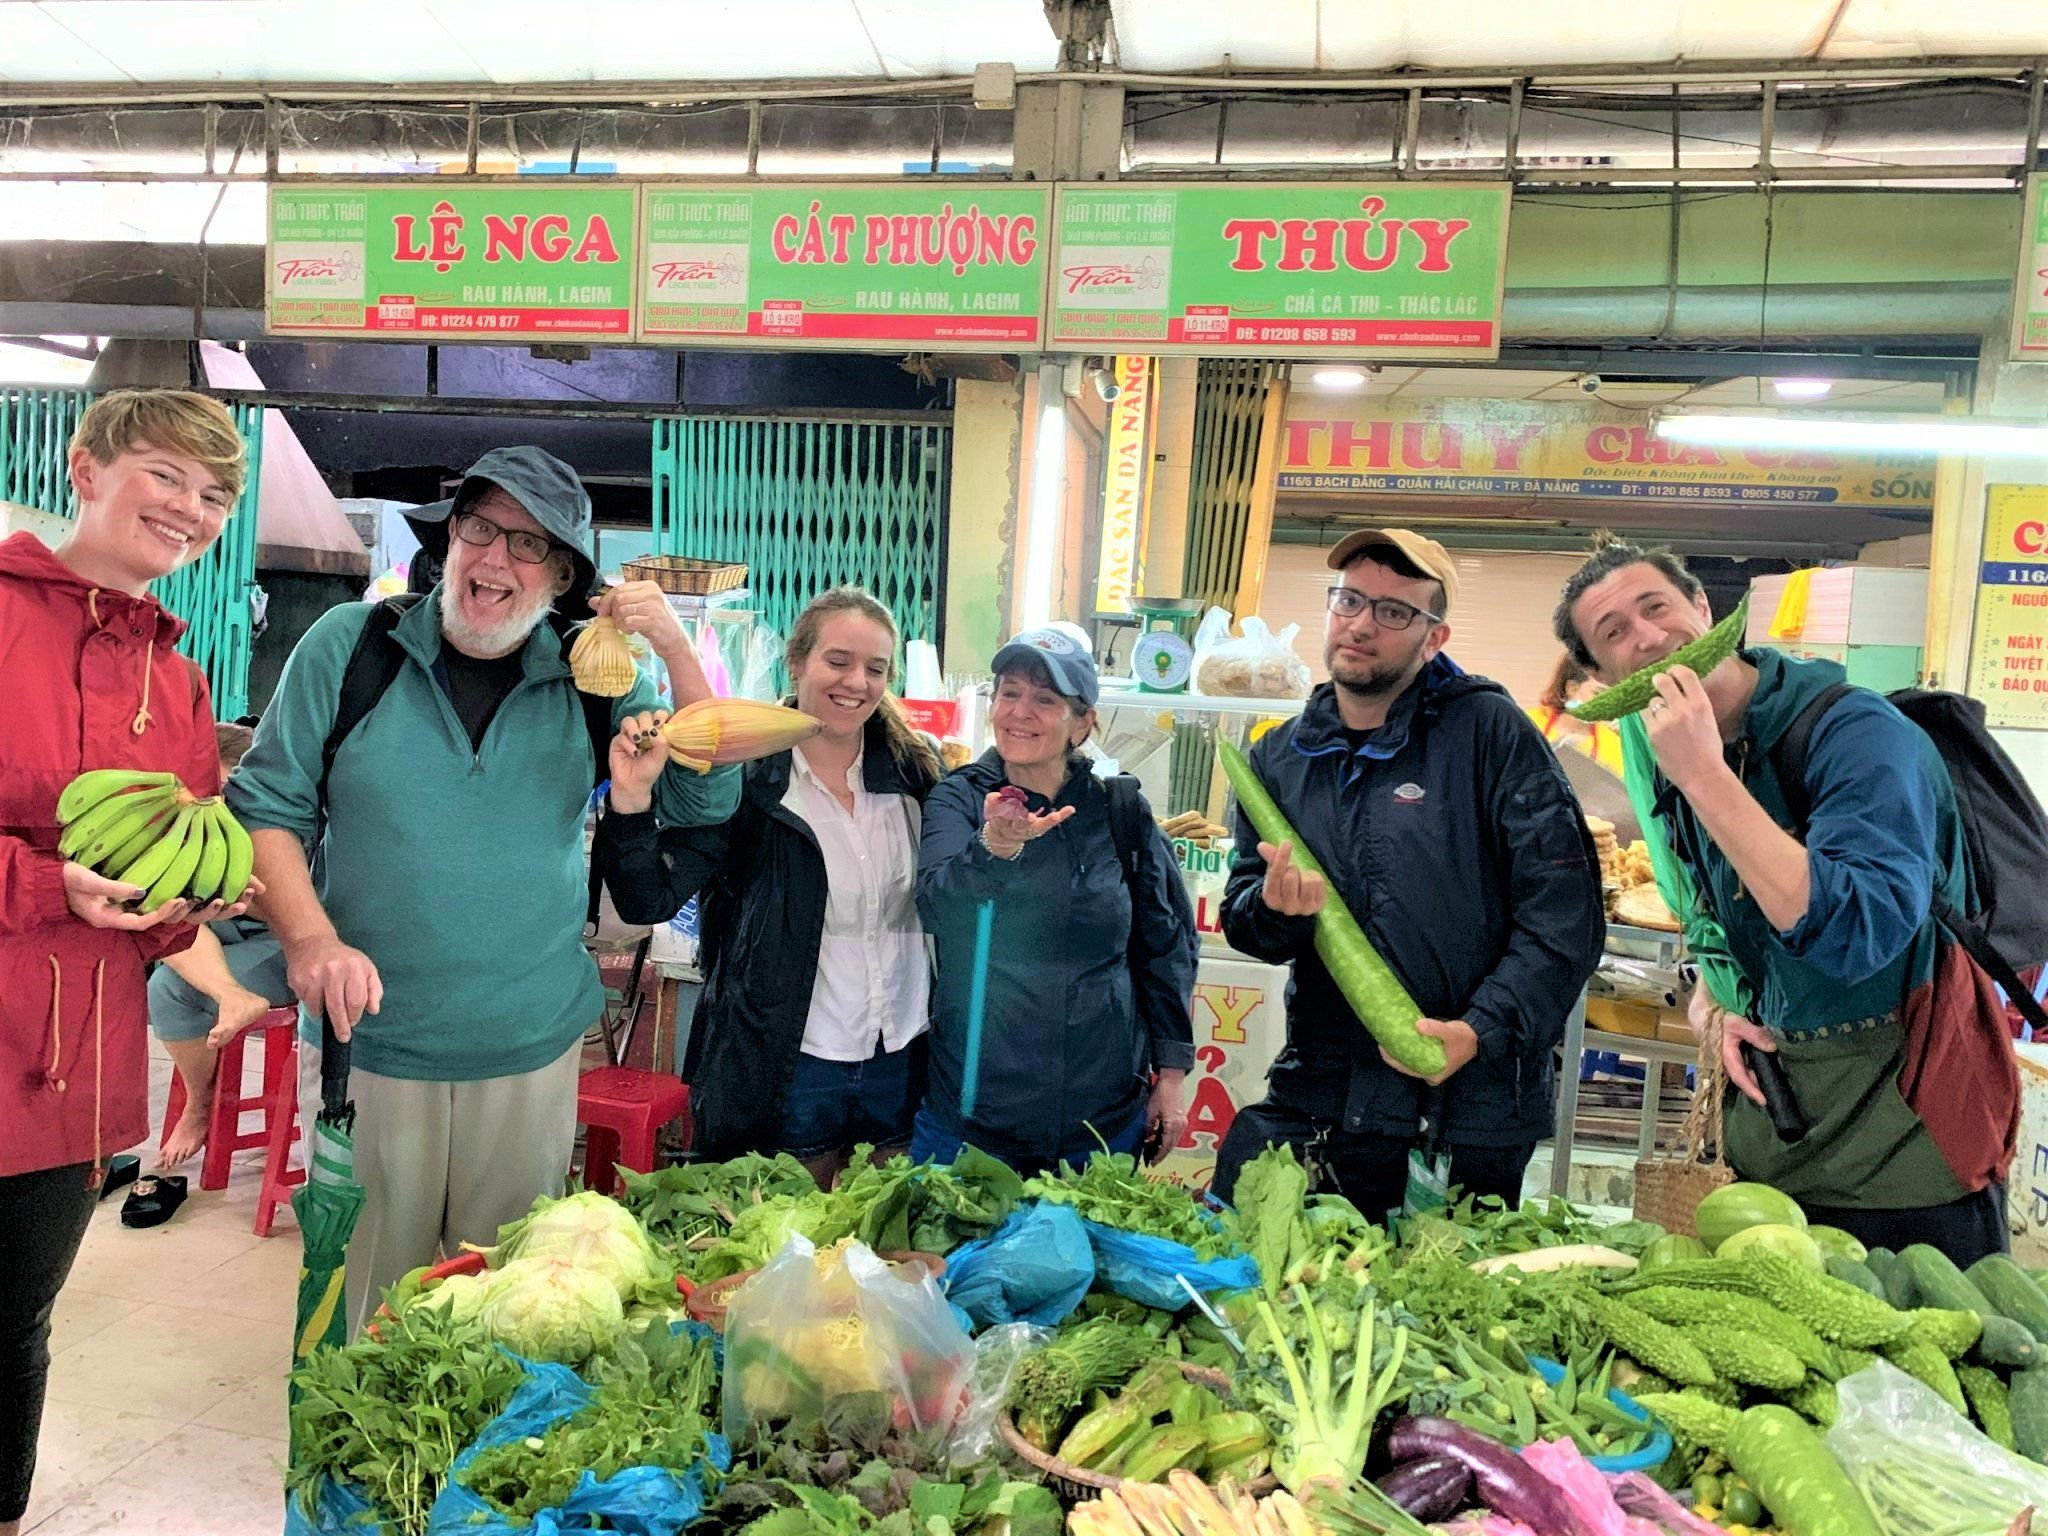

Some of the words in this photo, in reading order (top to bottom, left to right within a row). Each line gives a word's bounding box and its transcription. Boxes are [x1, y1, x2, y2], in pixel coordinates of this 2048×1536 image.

[393, 200, 465, 273] LỆ
[484, 214, 620, 263] NGA
[772, 200, 856, 266] CÁT
[864, 203, 1038, 278] PHƯỢNG
[1222, 195, 1472, 273] THỦY
[463, 285, 496, 303] RAU
[560, 286, 612, 304] LAGIM
[856, 291, 893, 309] RAU
[899, 288, 955, 312] HÀNH,
[963, 293, 1020, 311] LAGIM
[1350, 295, 1380, 314] THU
[441, 314, 473, 328] 01224
[1260, 327, 1299, 341] 01208
[1302, 327, 1327, 341] 658
[1330, 327, 1357, 342] 593
[1315, 476, 1349, 488] BẠCH
[1503, 481, 1521, 492] TP.
[1648, 485, 1675, 496] 0120
[1679, 486, 1699, 497] 865
[1702, 487, 1731, 498] 8593
[1742, 488, 1770, 499] 0905
[1773, 489, 1794, 500] 450
[1797, 489, 1820, 500] 577
[2013, 520, 2048, 557] C
[672, 895, 697, 934] AQU
[1176, 1045, 1238, 1151] Ả
